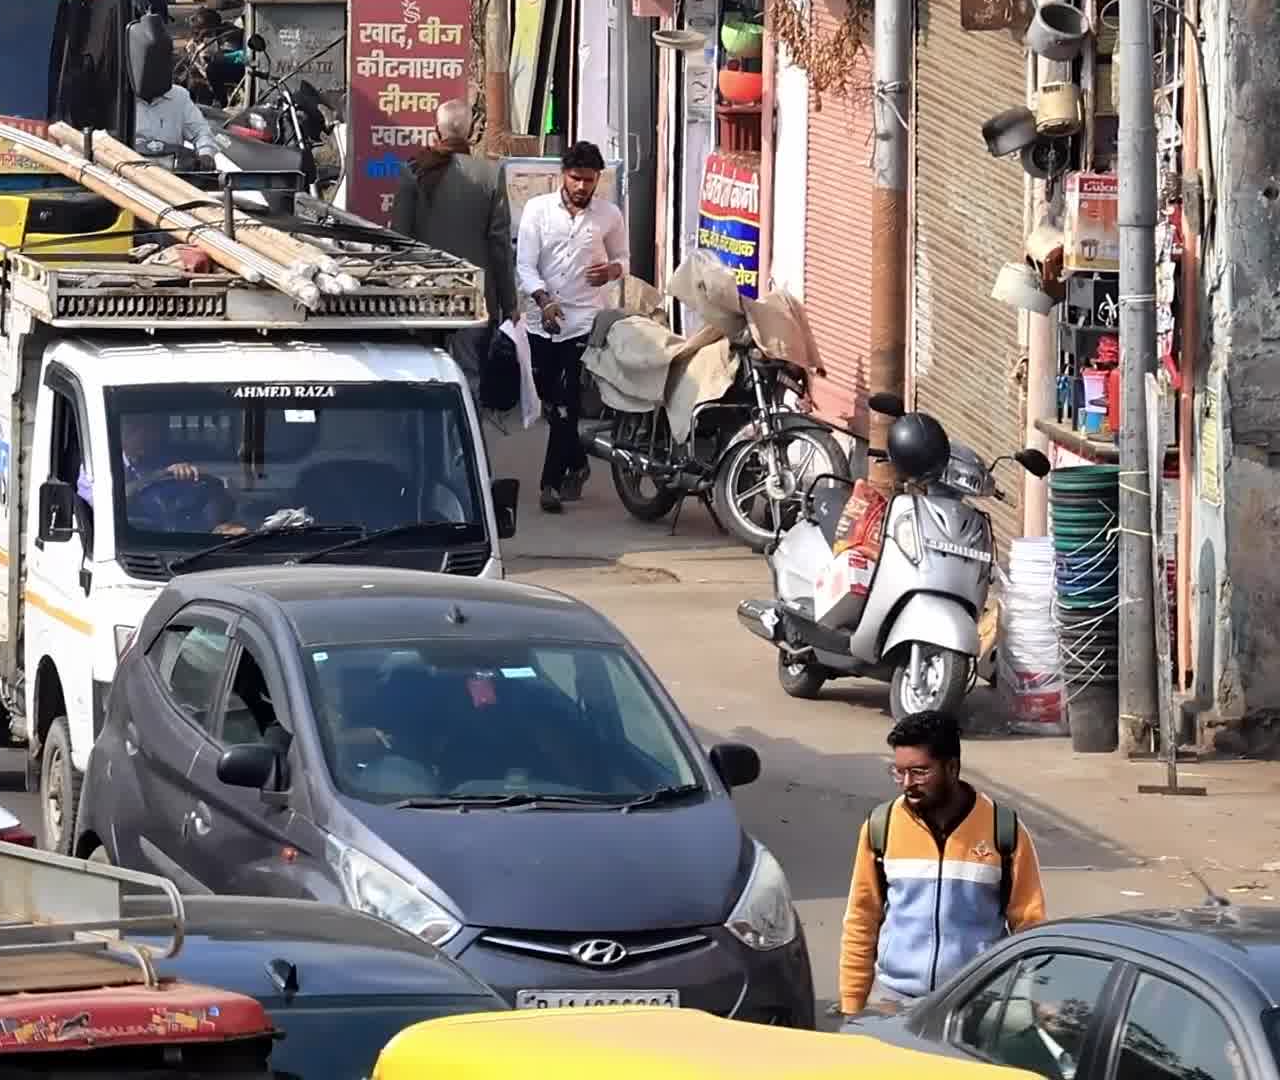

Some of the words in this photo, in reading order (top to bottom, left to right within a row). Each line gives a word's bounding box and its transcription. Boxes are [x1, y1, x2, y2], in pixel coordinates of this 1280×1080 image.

[417, 16, 464, 46] बीज
[356, 49, 465, 80] कीटनाशक
[378, 84, 441, 117] दीमक
[233, 386, 291, 398] AHMED
[294, 385, 335, 398] RAZA
